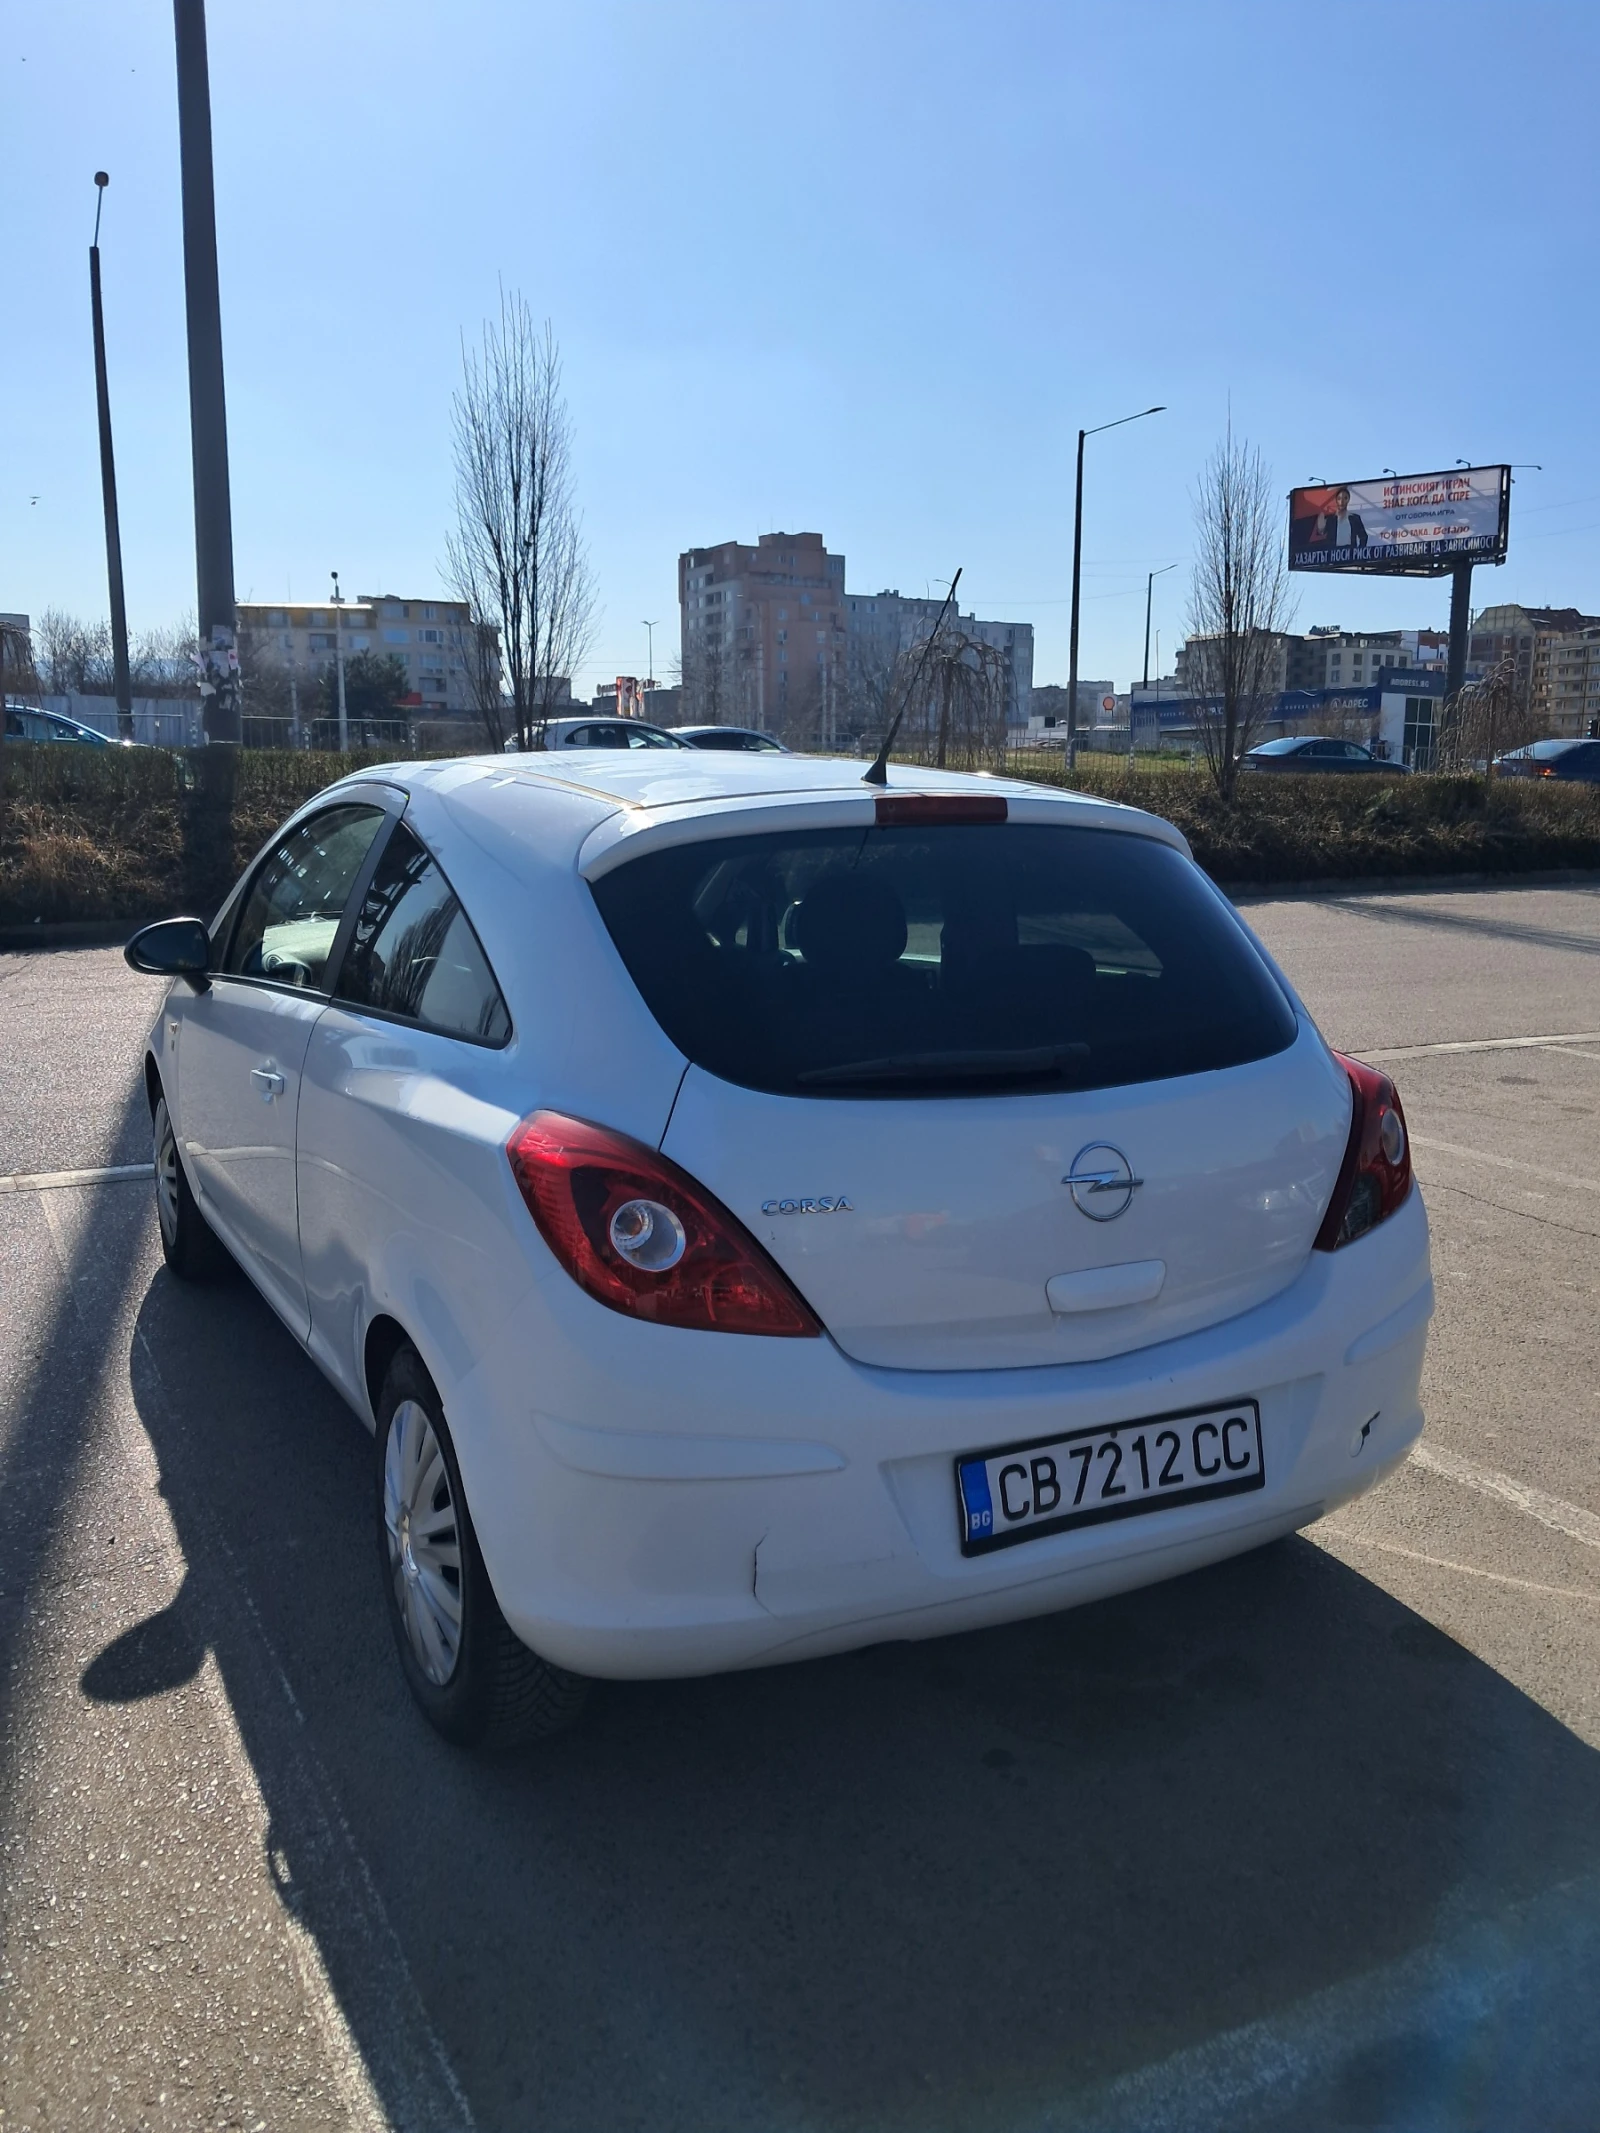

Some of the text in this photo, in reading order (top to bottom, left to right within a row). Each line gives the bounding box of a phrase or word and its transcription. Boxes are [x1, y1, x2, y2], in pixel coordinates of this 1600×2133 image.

[1383, 478, 1470, 497] ИСТИНСКИЯТ ИГРАЧ
[1383, 490, 1470, 509] ЗНАЕ КОГА ДА СПРЕ
[1437, 508, 1455, 517] ИГРА
[1380, 529, 1408, 539] ТОЧНО
[1433, 525, 1470, 536] Betano
[1294, 536, 1495, 566] ХАЗАРТЪТ НОСИ РИСК ОТ РАЗВИВАНЕ НА ЗАВИСИМОСТ
[1341, 698, 1369, 709] АДРЕС
[761, 1195, 854, 1216] CORSA
[970, 1509, 991, 1530] BG
